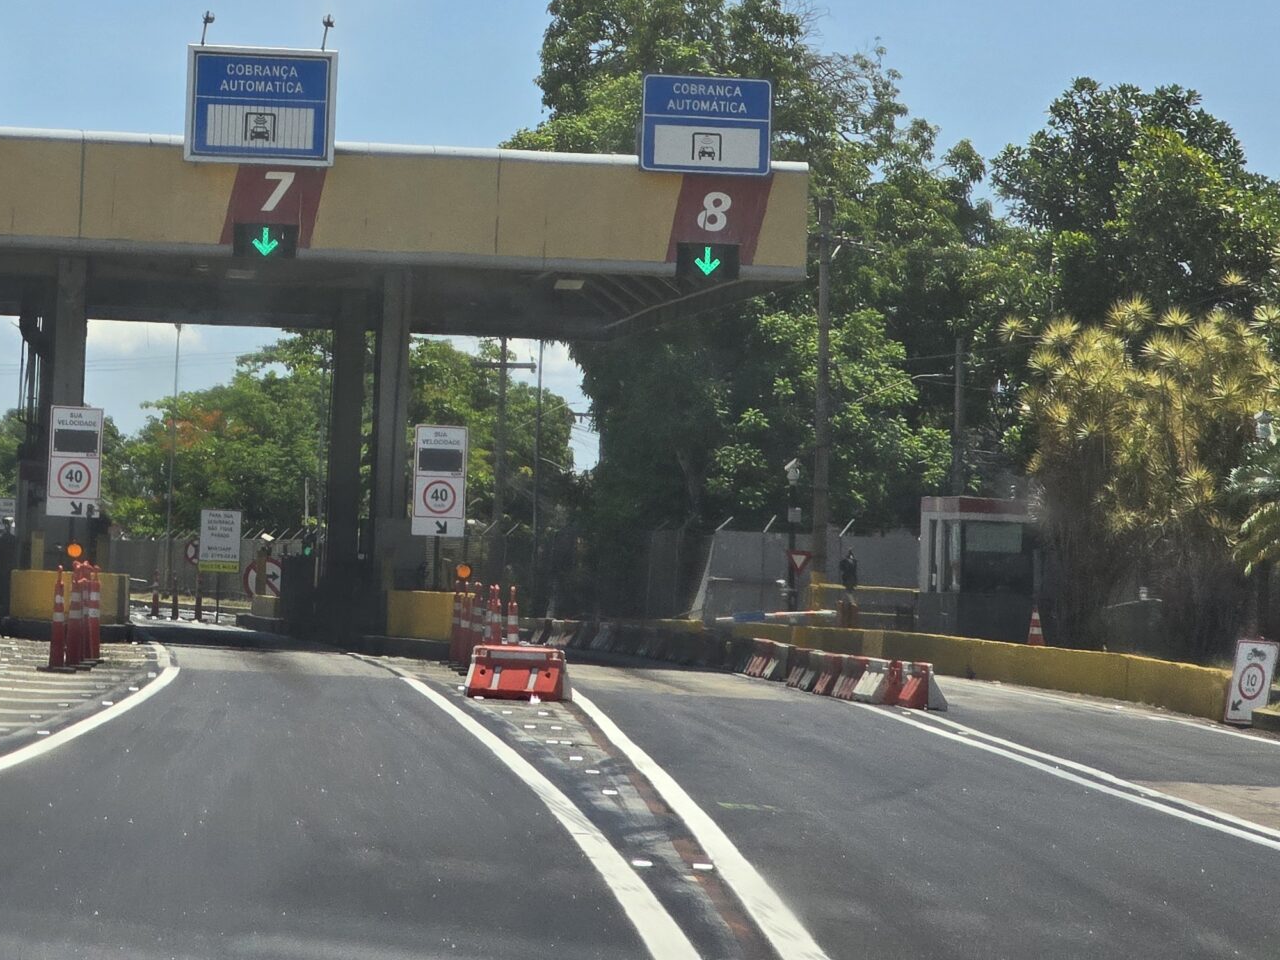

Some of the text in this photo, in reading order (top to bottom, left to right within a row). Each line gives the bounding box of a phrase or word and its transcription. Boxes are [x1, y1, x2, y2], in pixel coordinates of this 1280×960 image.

[226, 63, 298, 80] COBRANÇA
[672, 83, 742, 98] COBRANÇA
[667, 97, 748, 114] AUTOMÁTICA
[260, 171, 296, 211] 7
[697, 191, 732, 232] 8
[65, 469, 83, 483] 40
[431, 488, 448, 502] 40
[1246, 674, 1258, 687] 10
